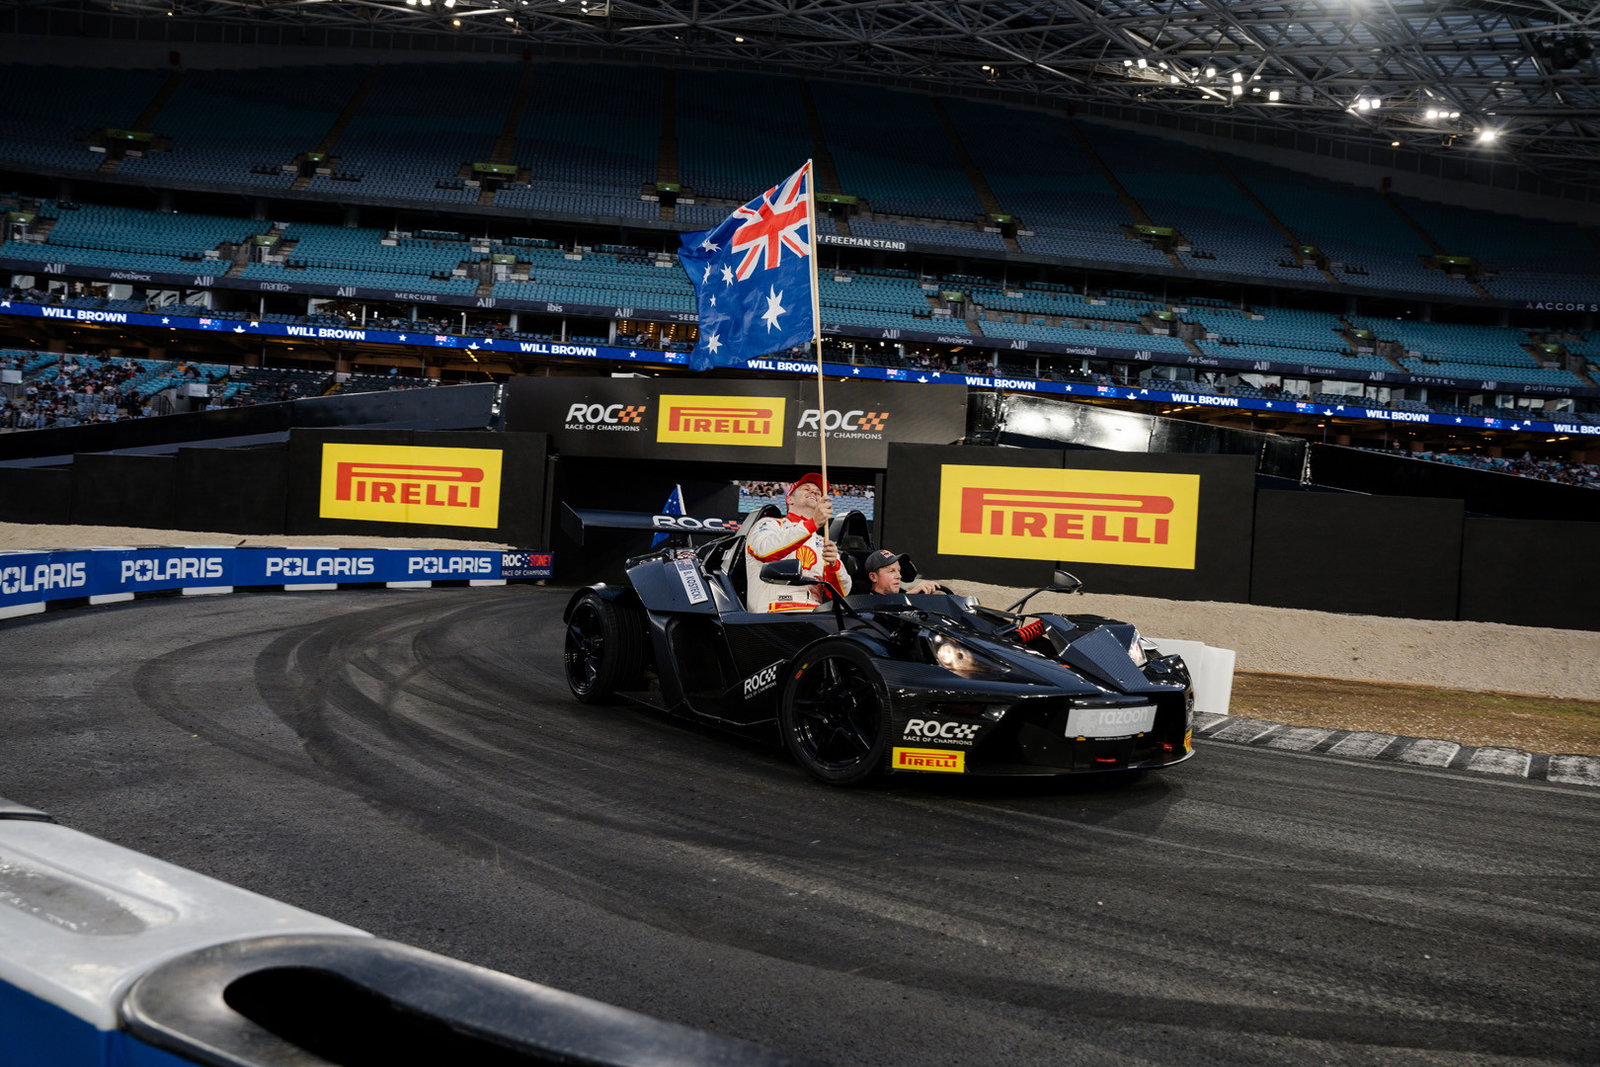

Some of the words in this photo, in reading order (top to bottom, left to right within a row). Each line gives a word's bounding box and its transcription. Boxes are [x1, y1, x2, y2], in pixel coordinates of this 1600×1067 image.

[825, 235, 870, 247] FREEMAN
[873, 240, 905, 250] STAND
[395, 293, 438, 301] MERCURE
[547, 303, 562, 312] ibis
[1536, 302, 1585, 311] ACCOR
[42, 306, 75, 319] WILL
[77, 310, 126, 323] BROWN
[286, 326, 316, 337] WILL
[319, 328, 365, 340] BROWN
[520, 343, 549, 354] WILL
[551, 345, 596, 356] BROWN
[747, 360, 775, 370] WILL
[966, 376, 992, 387] WILL
[994, 379, 1035, 390] BROWN
[1410, 376, 1456, 385] SOFITEL
[1524, 384, 1570, 394] pullman
[1172, 393, 1197, 403] WILL
[1199, 396, 1238, 406] BROWN
[565, 403, 624, 423] ROC
[669, 407, 773, 434] PIRELLI
[797, 409, 864, 430] ROC
[1366, 409, 1390, 419] WILL
[1392, 412, 1429, 422] BROWN
[1553, 424, 1579, 433] WILL
[1581, 425, 1600, 434] BRO
[336, 462, 484, 508] PIRELLI
[652, 515, 726, 530] ROC
[960, 487, 1174, 544] PIRELLI
[266, 557, 374, 576] POLARIS
[408, 557, 492, 574] POLARIS
[502, 554, 522, 566] ROC
[120, 557, 223, 583] POLARIS
[0, 562, 86, 594] OLARIS
[744, 670, 767, 695] ROC
[1100, 708, 1148, 725] razoon
[904, 719, 959, 738] ROC
[899, 752, 957, 767] PIRELLI
